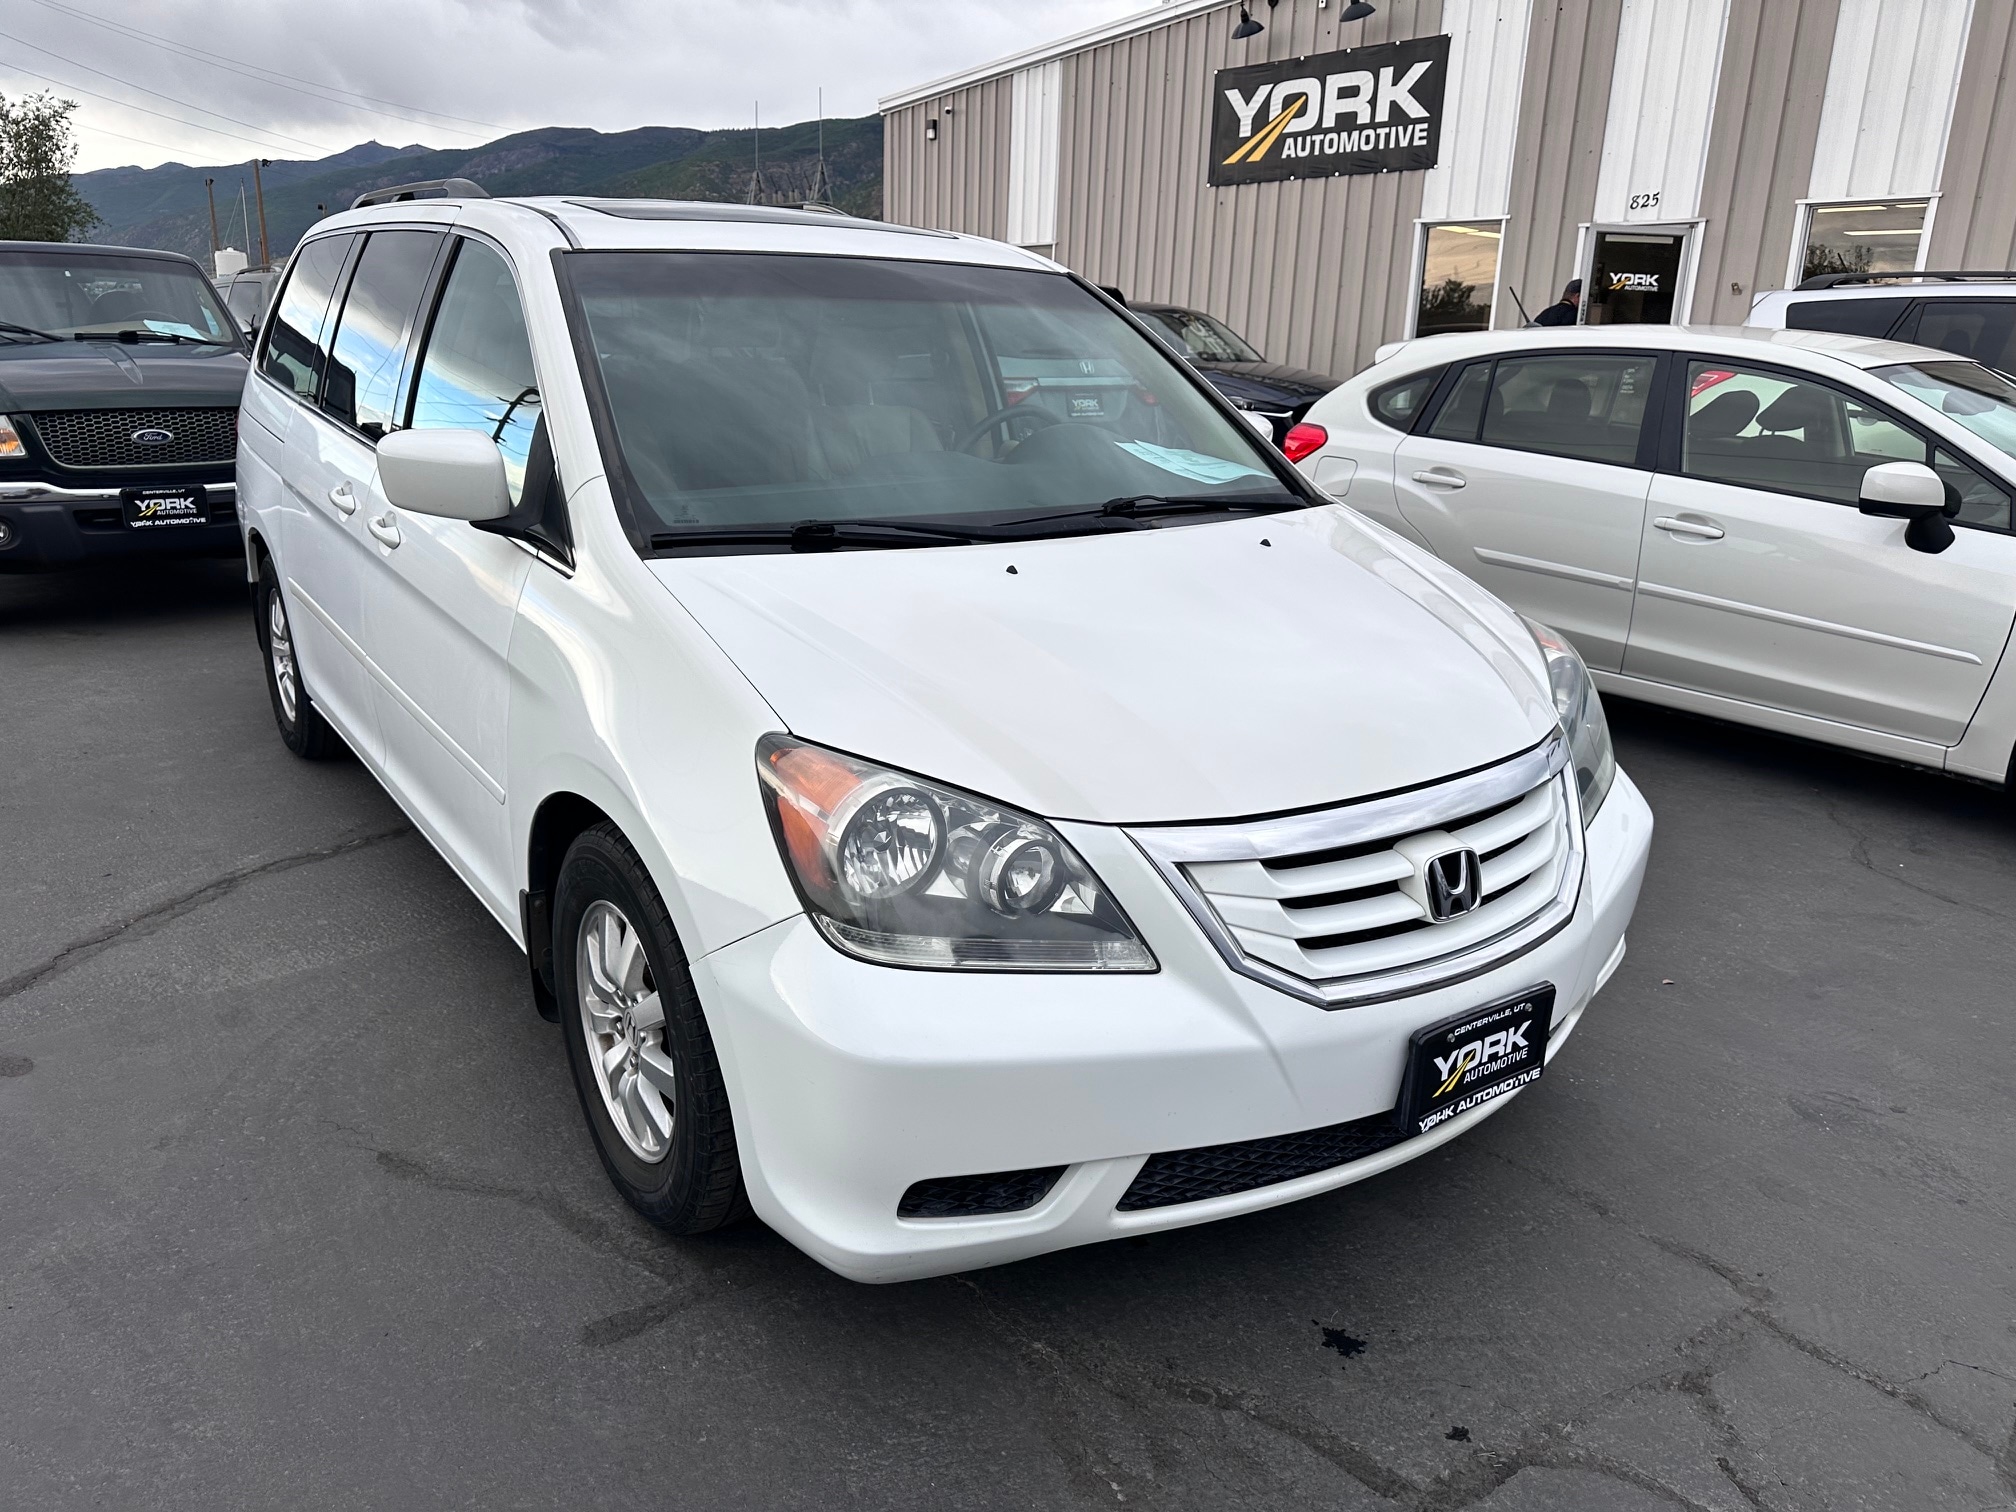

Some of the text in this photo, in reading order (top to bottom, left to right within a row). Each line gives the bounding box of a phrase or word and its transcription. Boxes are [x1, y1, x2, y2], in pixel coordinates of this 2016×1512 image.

[1224, 60, 1434, 138] YORK
[1281, 122, 1429, 160] AUTOMOTIVE
[1629, 191, 1660, 210] 825
[1609, 272, 1660, 286] YORK
[143, 432, 163, 441] Ford
[134, 497, 196, 511] YORK
[157, 508, 197, 516] AUTOMOTIVE
[130, 517, 206, 528] YORK AUTOMOTIVE
[1454, 1003, 1526, 1036] CENTERVILLE, UT
[1433, 1020, 1532, 1082] YORK
[1463, 1047, 1528, 1084] AUTOMOTIVE
[1456, 1067, 1541, 1113] AUTOMOTIVE
